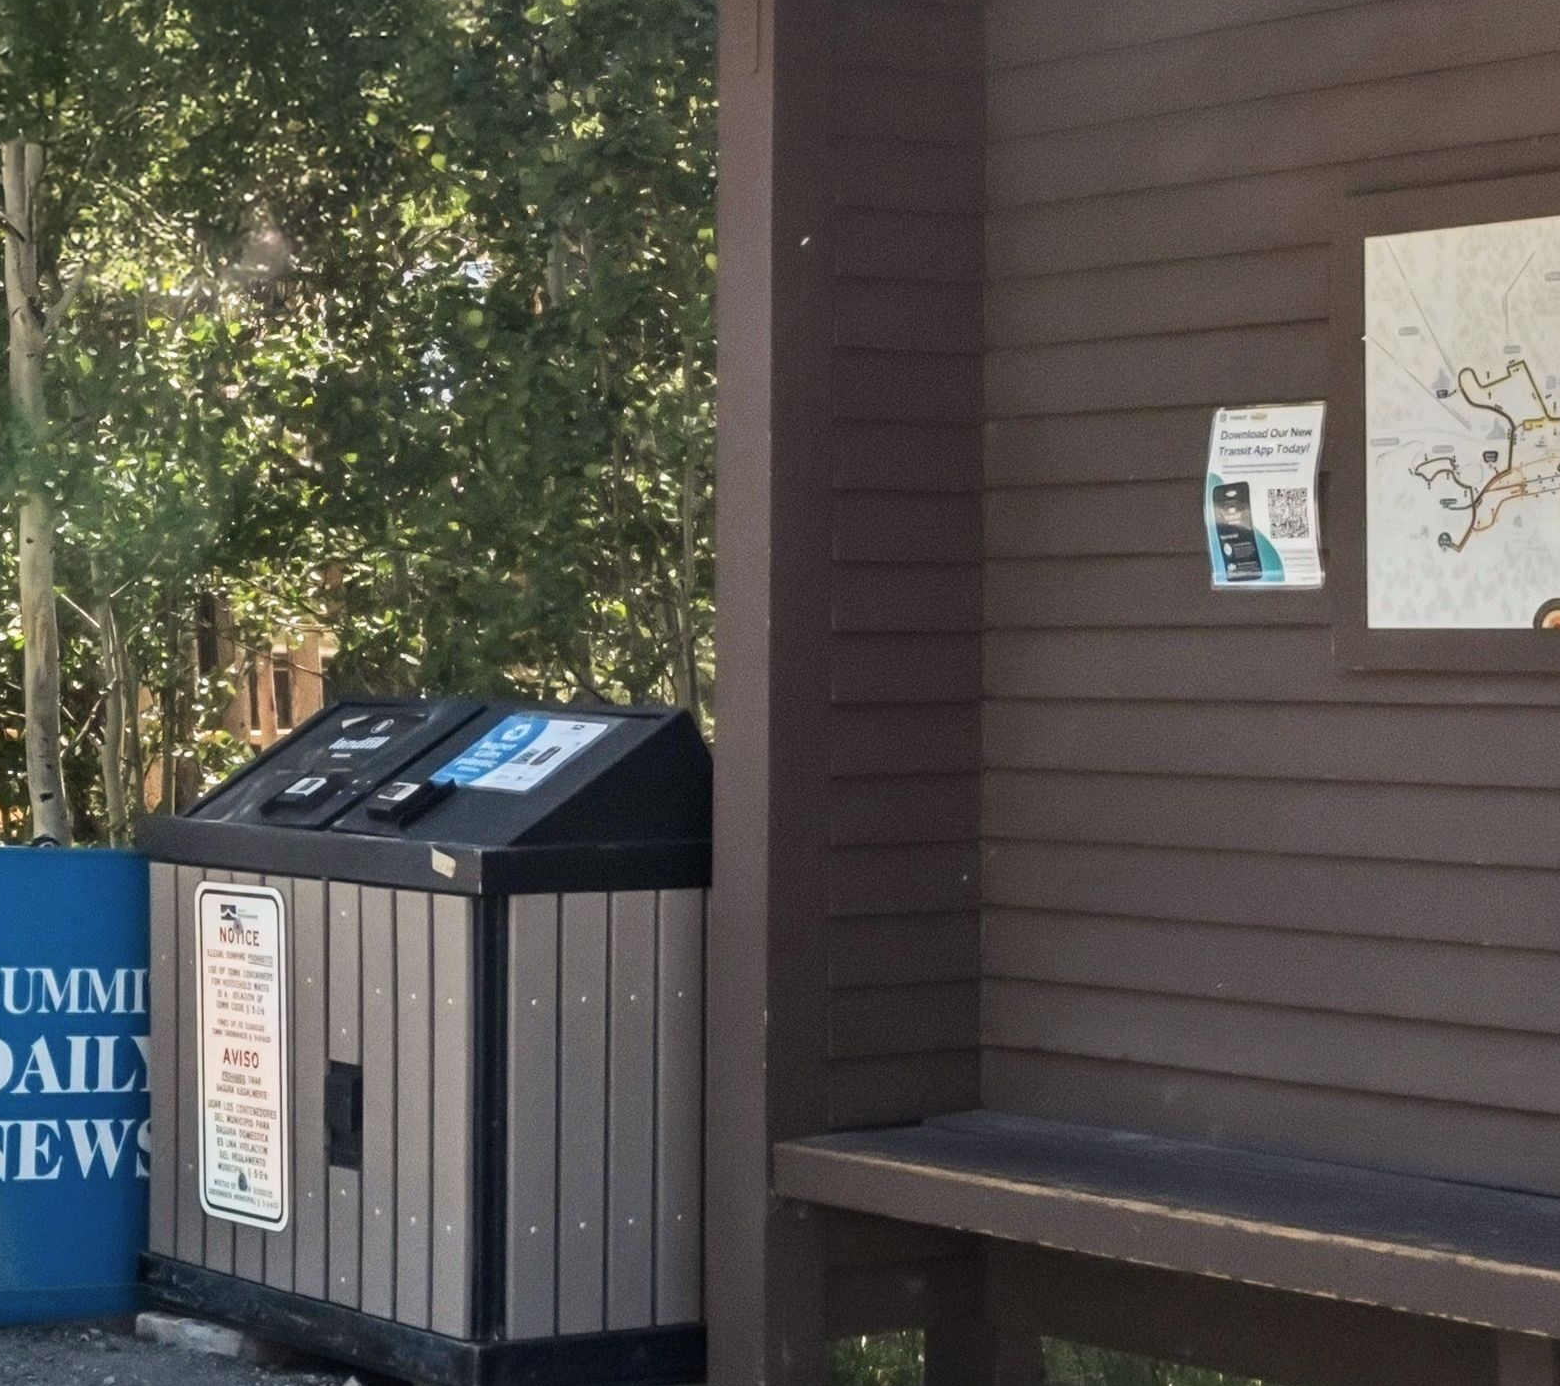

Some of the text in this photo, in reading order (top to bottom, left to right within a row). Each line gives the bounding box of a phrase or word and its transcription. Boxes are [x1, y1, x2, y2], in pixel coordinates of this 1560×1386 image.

[1220, 426, 1313, 440] Download Our New
[1219, 442, 1311, 458] Transit App Today!
[219, 926, 260, 947] NOTICE
[222, 1047, 260, 1069] AVISO
